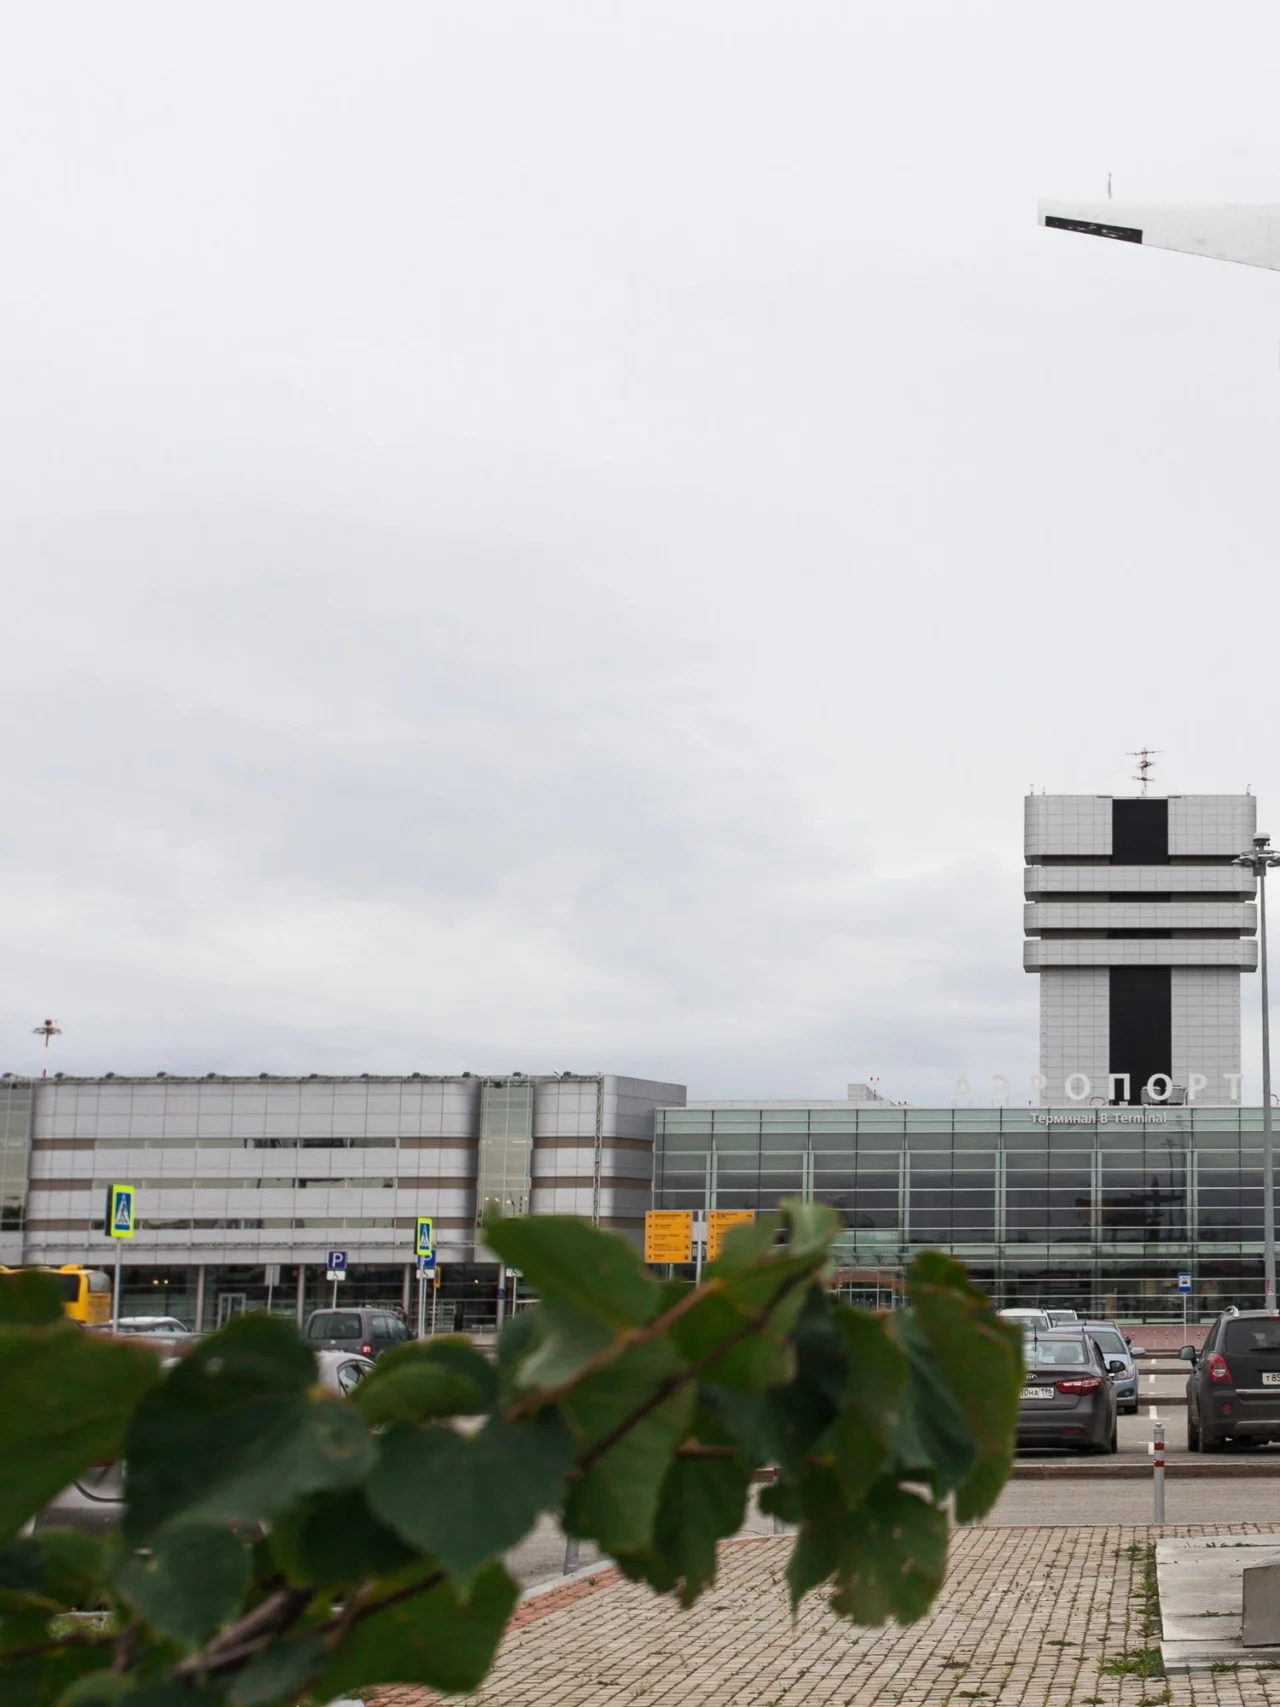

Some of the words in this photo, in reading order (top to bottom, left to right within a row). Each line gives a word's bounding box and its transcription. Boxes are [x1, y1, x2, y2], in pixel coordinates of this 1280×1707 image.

[953, 1073, 1244, 1101] АЭРОПОРТ
[1030, 1112, 1096, 1126] Терминал
[1113, 1112, 1167, 1123] Terminal
